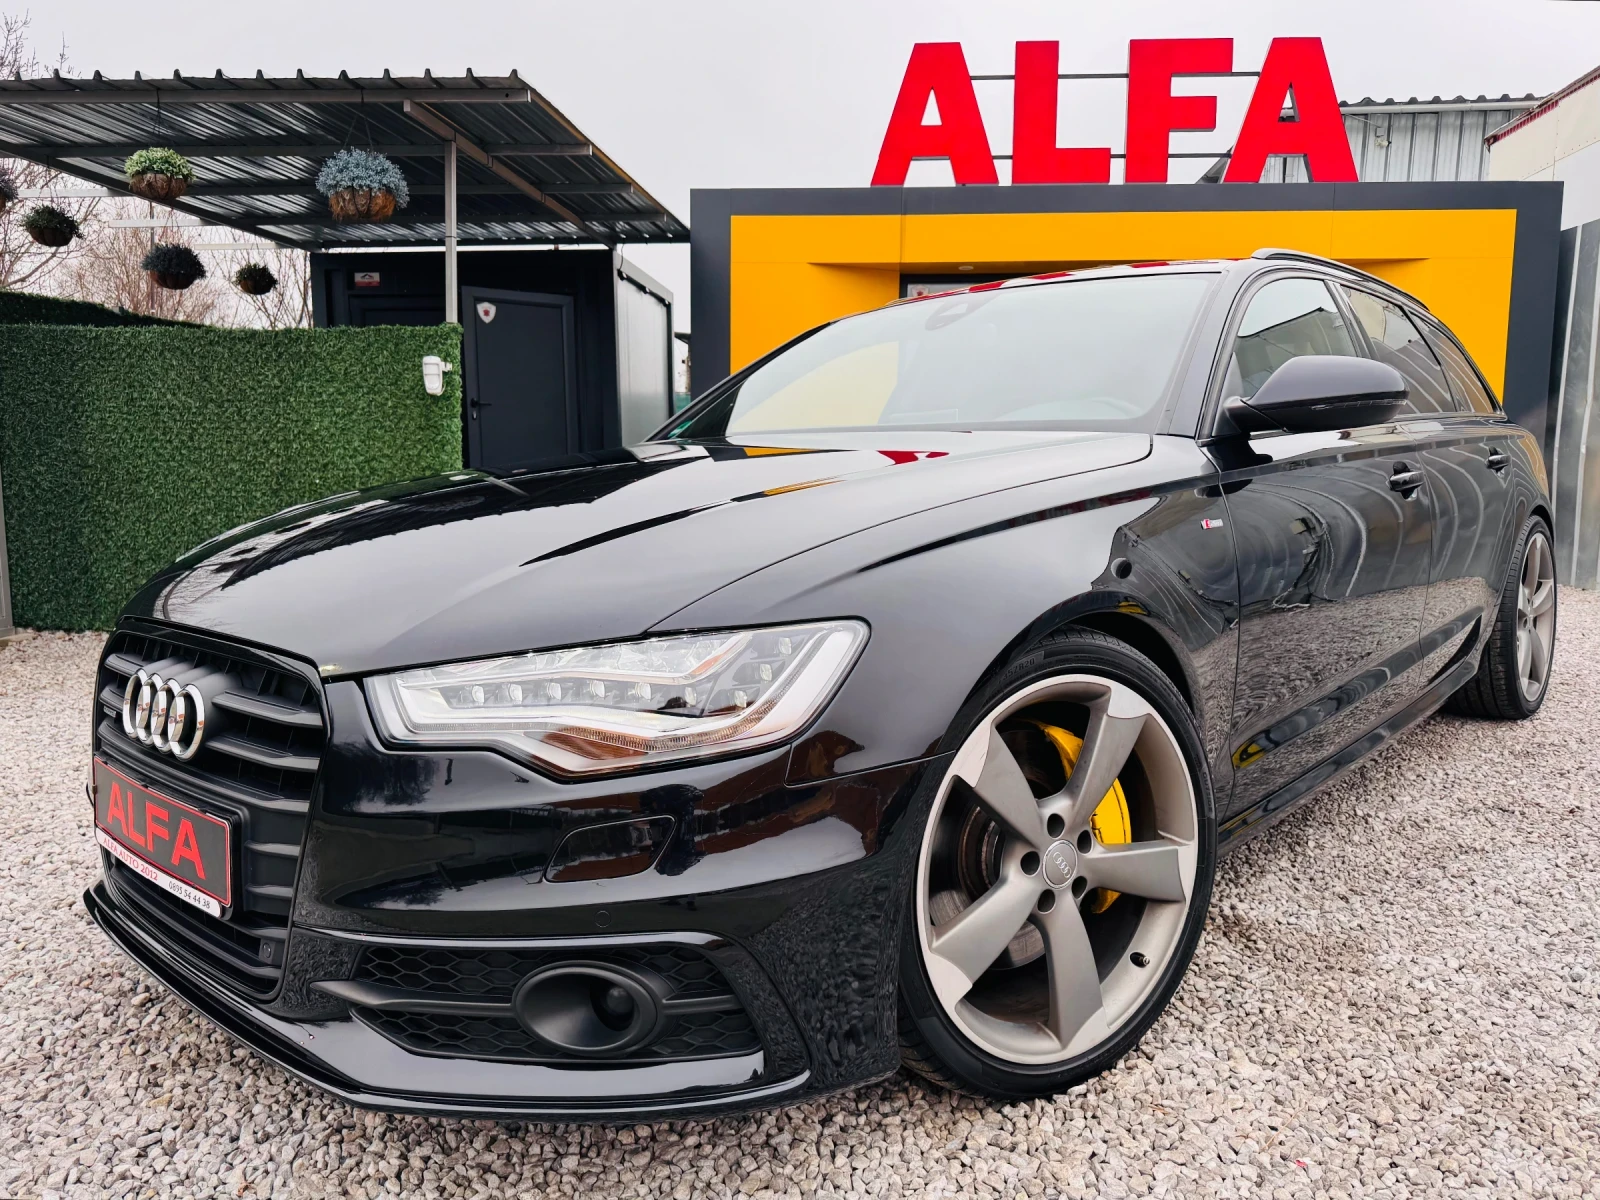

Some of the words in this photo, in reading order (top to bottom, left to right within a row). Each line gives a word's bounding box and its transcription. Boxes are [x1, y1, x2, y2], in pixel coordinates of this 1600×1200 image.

[870, 37, 1358, 187] ALFA
[103, 838, 118, 855] ALFA
[119, 849, 139, 869] AUTO
[140, 863, 158, 881] 2012
[107, 781, 206, 880] ALFA
[168, 881, 183, 895] 0895
[184, 889, 192, 900] 54
[193, 894, 201, 904] 44
[202, 898, 211, 909] 38
